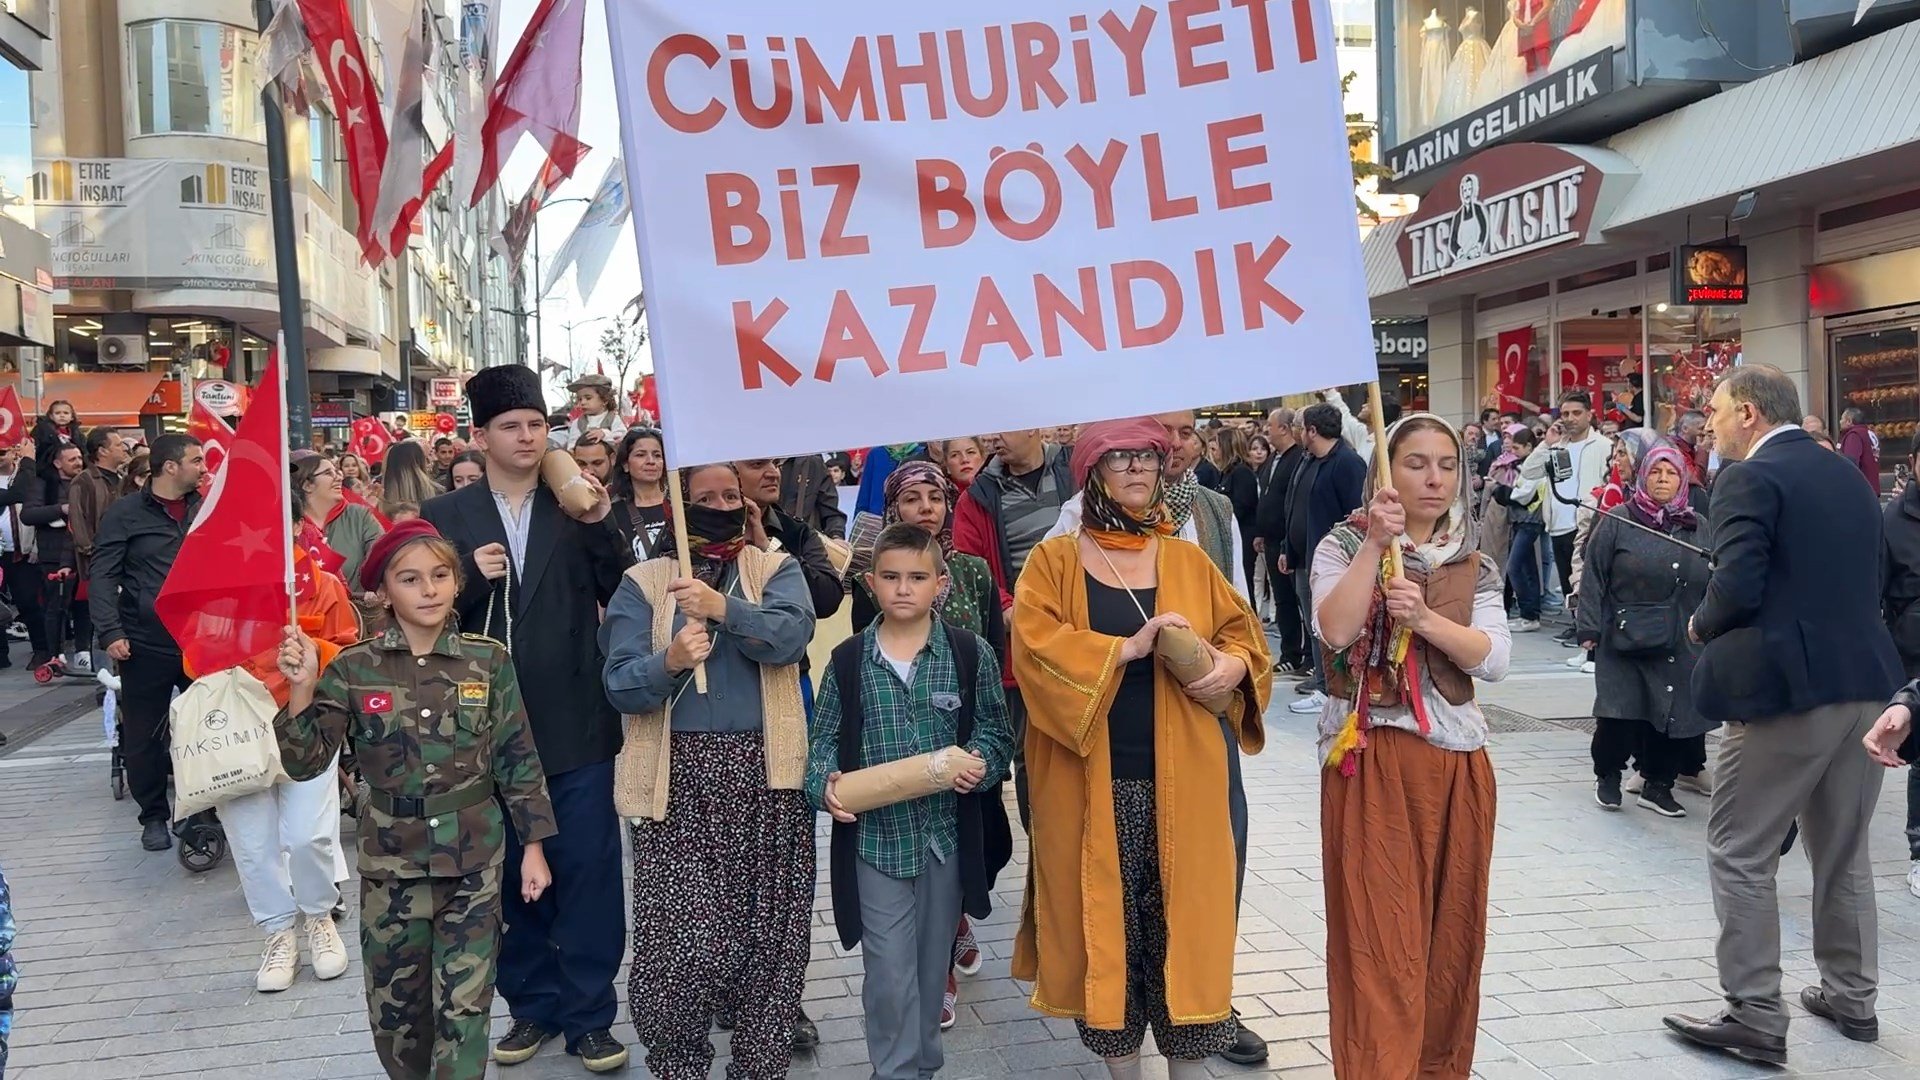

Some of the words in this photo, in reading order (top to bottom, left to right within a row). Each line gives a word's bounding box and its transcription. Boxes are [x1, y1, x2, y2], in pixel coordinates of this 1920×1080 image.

[1391, 128, 1459, 181] LARİN
[1468, 64, 1598, 147] GELİNLİK
[79, 162, 111, 179] ETRE
[231, 167, 258, 187] ETRE
[80, 181, 125, 204] İNŞAAT
[705, 164, 869, 266] BİZ
[915, 113, 1273, 249] BÖYLE
[1488, 178, 1579, 253] KASAP
[53, 250, 131, 263] NCIOĞULLARI
[731, 235, 1304, 390] KAZANDIK
[173, 721, 270, 760] TAKSIMIX
[211, 772, 230, 782] ONLINE
[230, 768, 244, 778] SHOP
